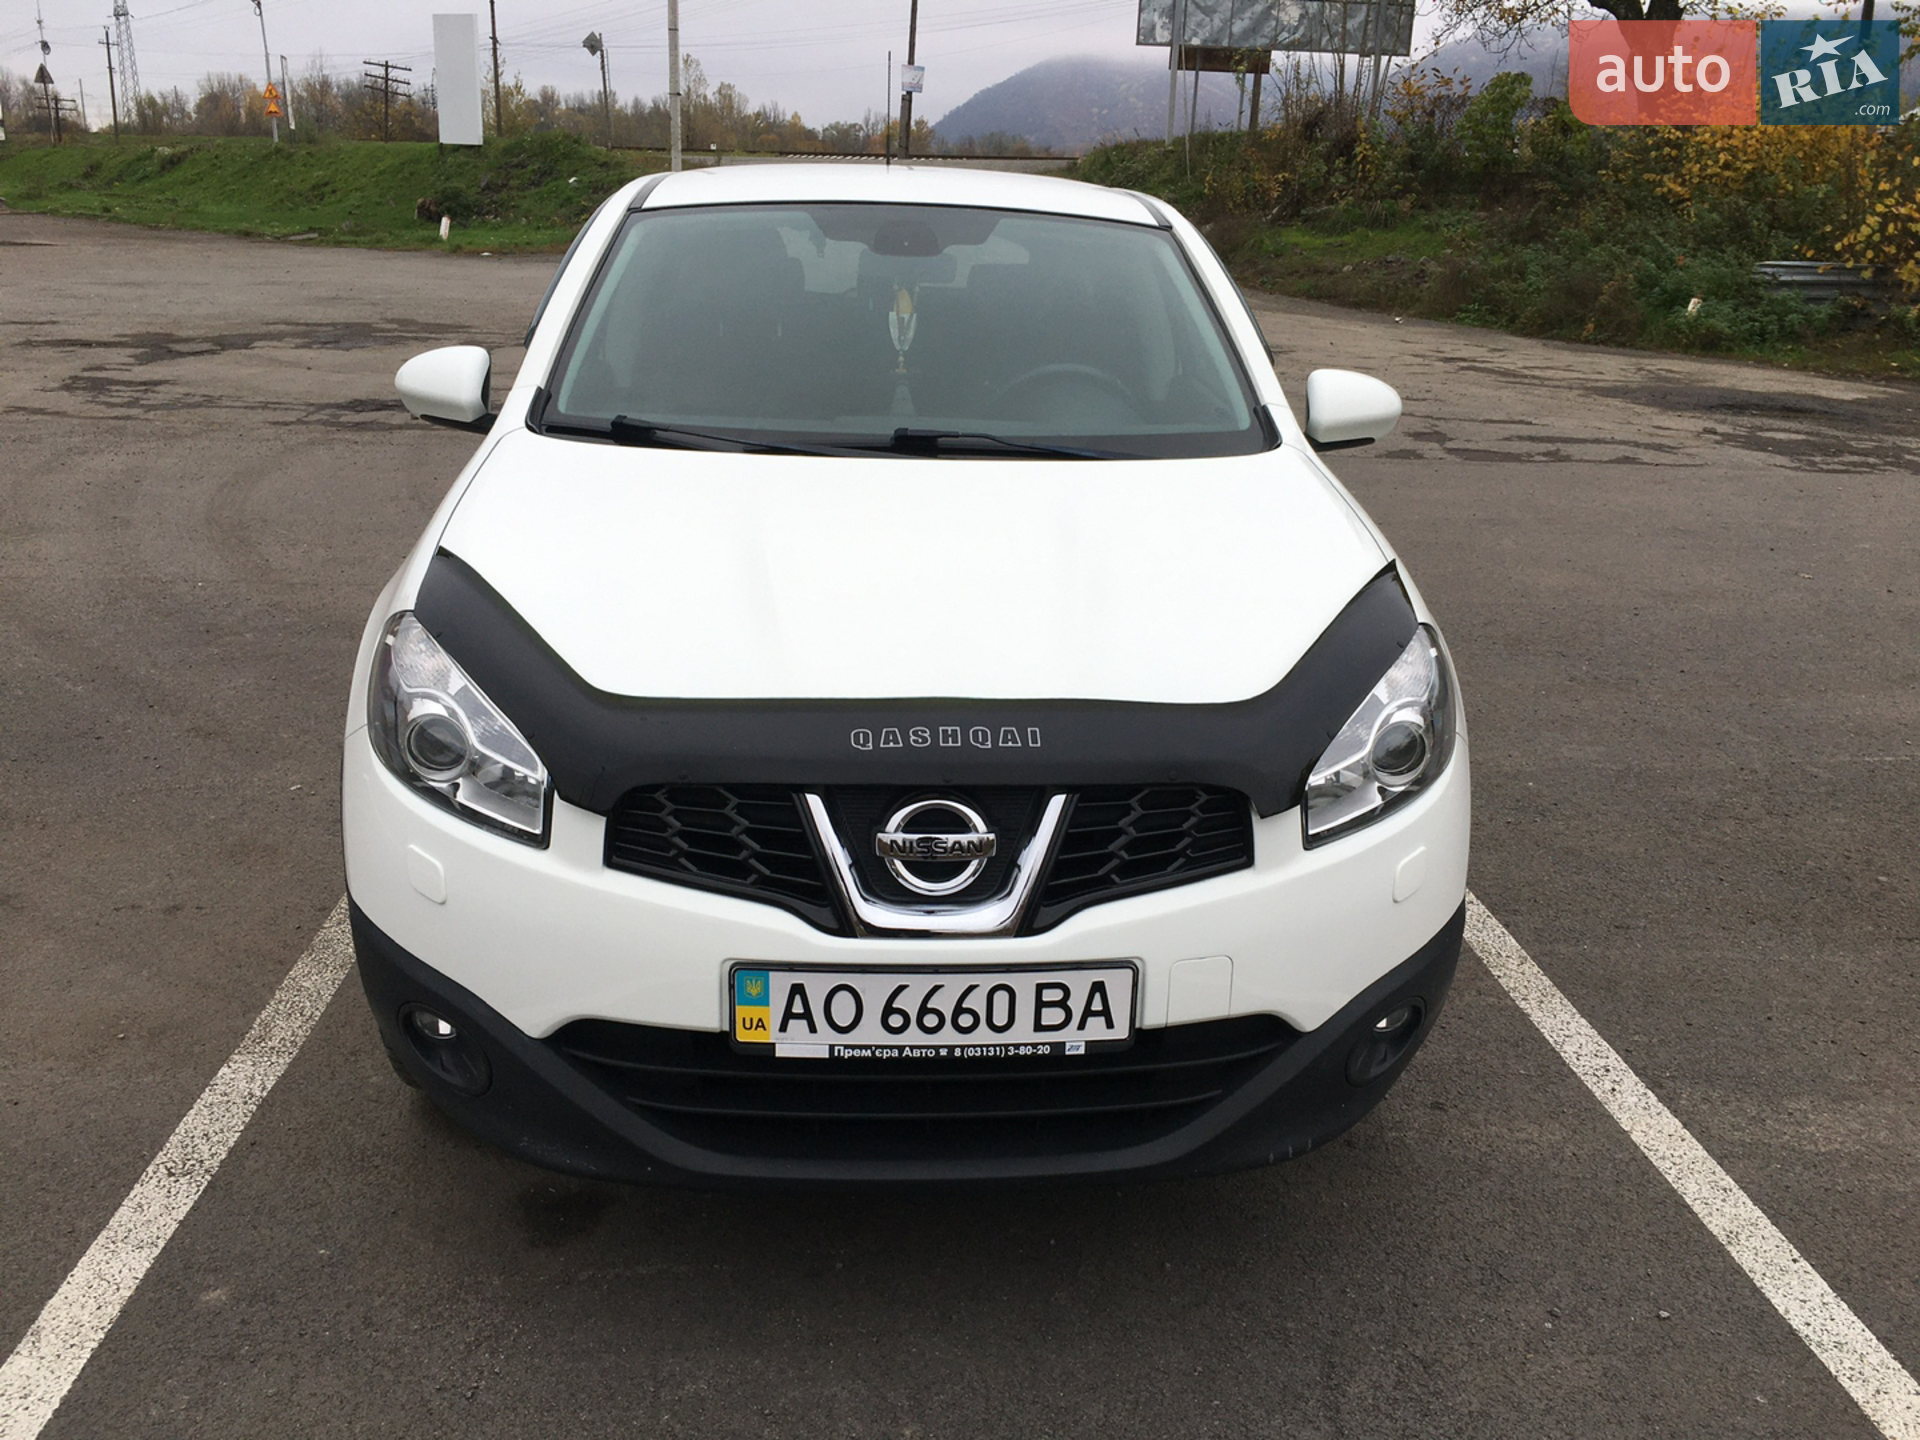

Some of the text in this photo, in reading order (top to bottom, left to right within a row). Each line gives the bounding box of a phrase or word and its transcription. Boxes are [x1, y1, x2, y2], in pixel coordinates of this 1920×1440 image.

[850, 726, 1042, 750] QASHQAI
[889, 836, 983, 855] NISSAN
[778, 980, 1115, 1035] AO 6660 BA
[742, 1016, 767, 1031] UA
[902, 1046, 936, 1058] Авто
[954, 1047, 962, 1057] 8
[963, 1046, 1005, 1058] (03131)
[1007, 1045, 1051, 1055] 3-80-20
